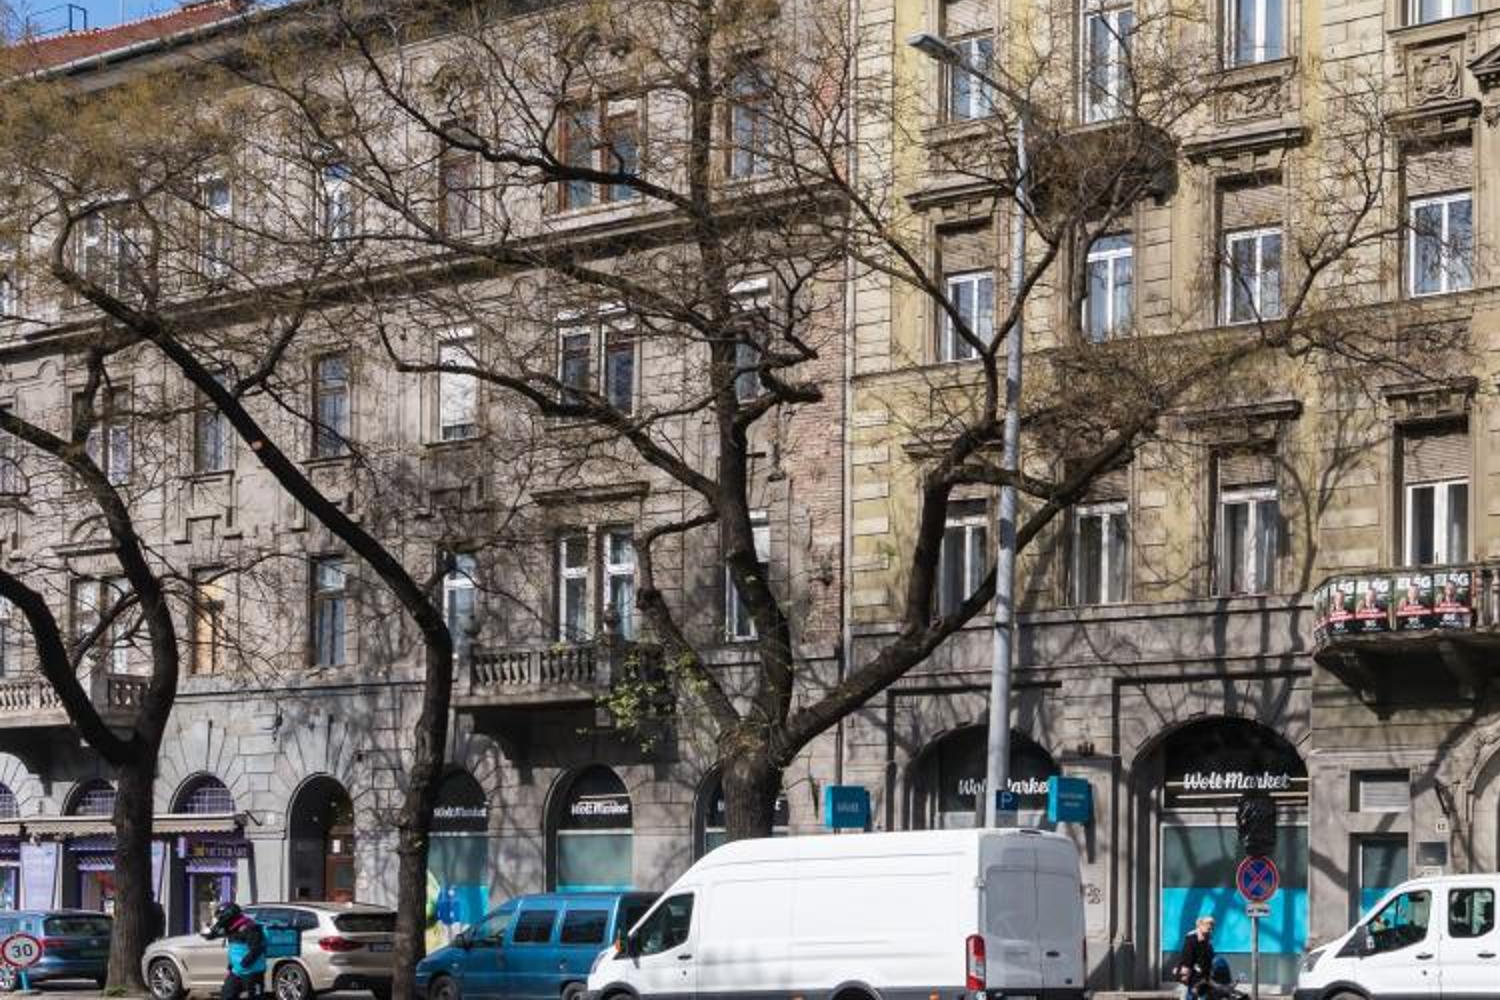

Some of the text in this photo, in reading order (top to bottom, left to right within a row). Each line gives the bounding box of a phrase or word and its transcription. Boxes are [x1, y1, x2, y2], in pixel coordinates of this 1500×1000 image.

[1183, 771, 1290, 791] Wolt Market
[11, 943, 33, 959] 30
